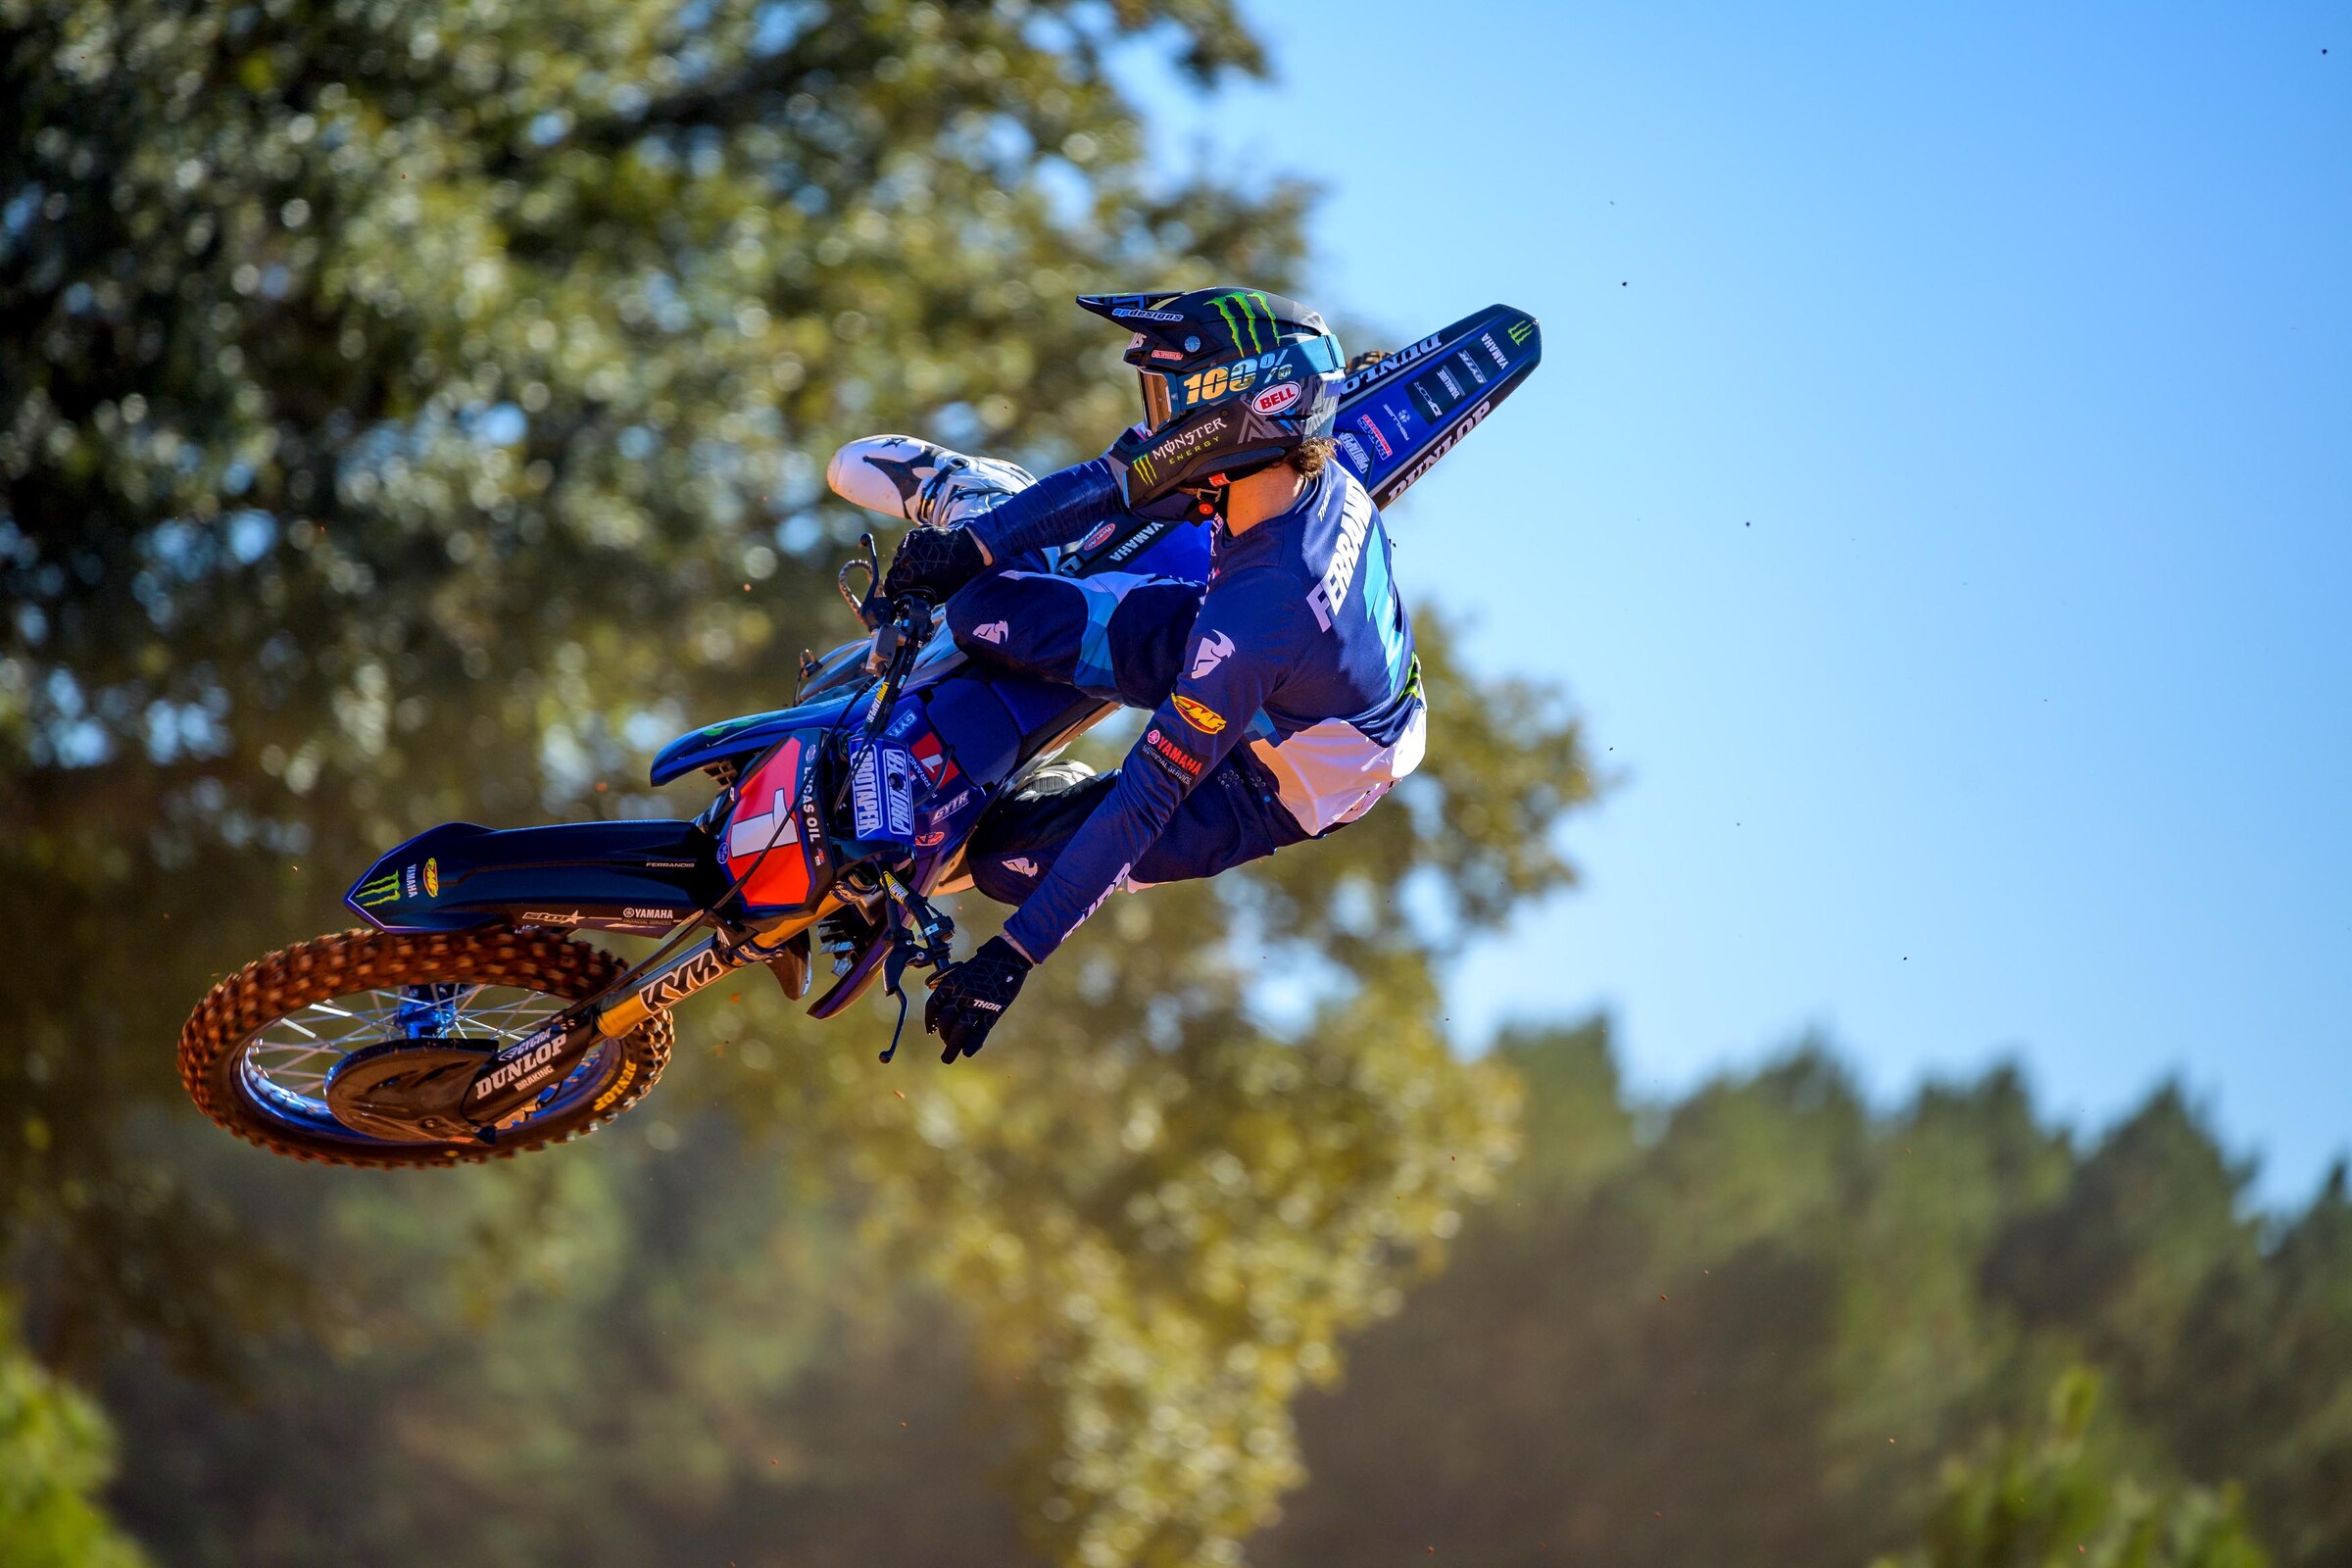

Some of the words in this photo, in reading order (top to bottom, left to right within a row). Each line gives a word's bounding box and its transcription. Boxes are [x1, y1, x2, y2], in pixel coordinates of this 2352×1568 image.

[1112, 308, 1184, 322] apdesigns
[1341, 332, 1443, 395] DUNLO
[1457, 350, 1486, 384] GYTR
[1481, 332, 1509, 370] YAMAHA
[1183, 348, 1293, 405] 100%
[1437, 368, 1460, 400] YAMALUBE
[1259, 387, 1296, 410] BELL
[1152, 417, 1228, 461] MONSTER
[1168, 436, 1220, 465] ENERGY
[1388, 400, 1491, 503] DUNLOP
[1109, 521, 1164, 562] YAMAHA
[888, 710, 917, 737] GYT
[921, 754, 943, 774] 1
[1157, 736, 1202, 774] YAMAHA
[854, 750, 880, 834] PROTAPER
[932, 790, 970, 823] GYTR
[730, 788, 799, 858] 1
[807, 816, 821, 843] OIL
[406, 863, 418, 899] YAMAHA
[634, 907, 674, 920] YAMAHA
[973, 1000, 1003, 1012] THOR
[516, 1028, 552, 1055] CYCRA
[475, 1033, 567, 1100] DUNLOP
[514, 1064, 555, 1092] BRAKING
